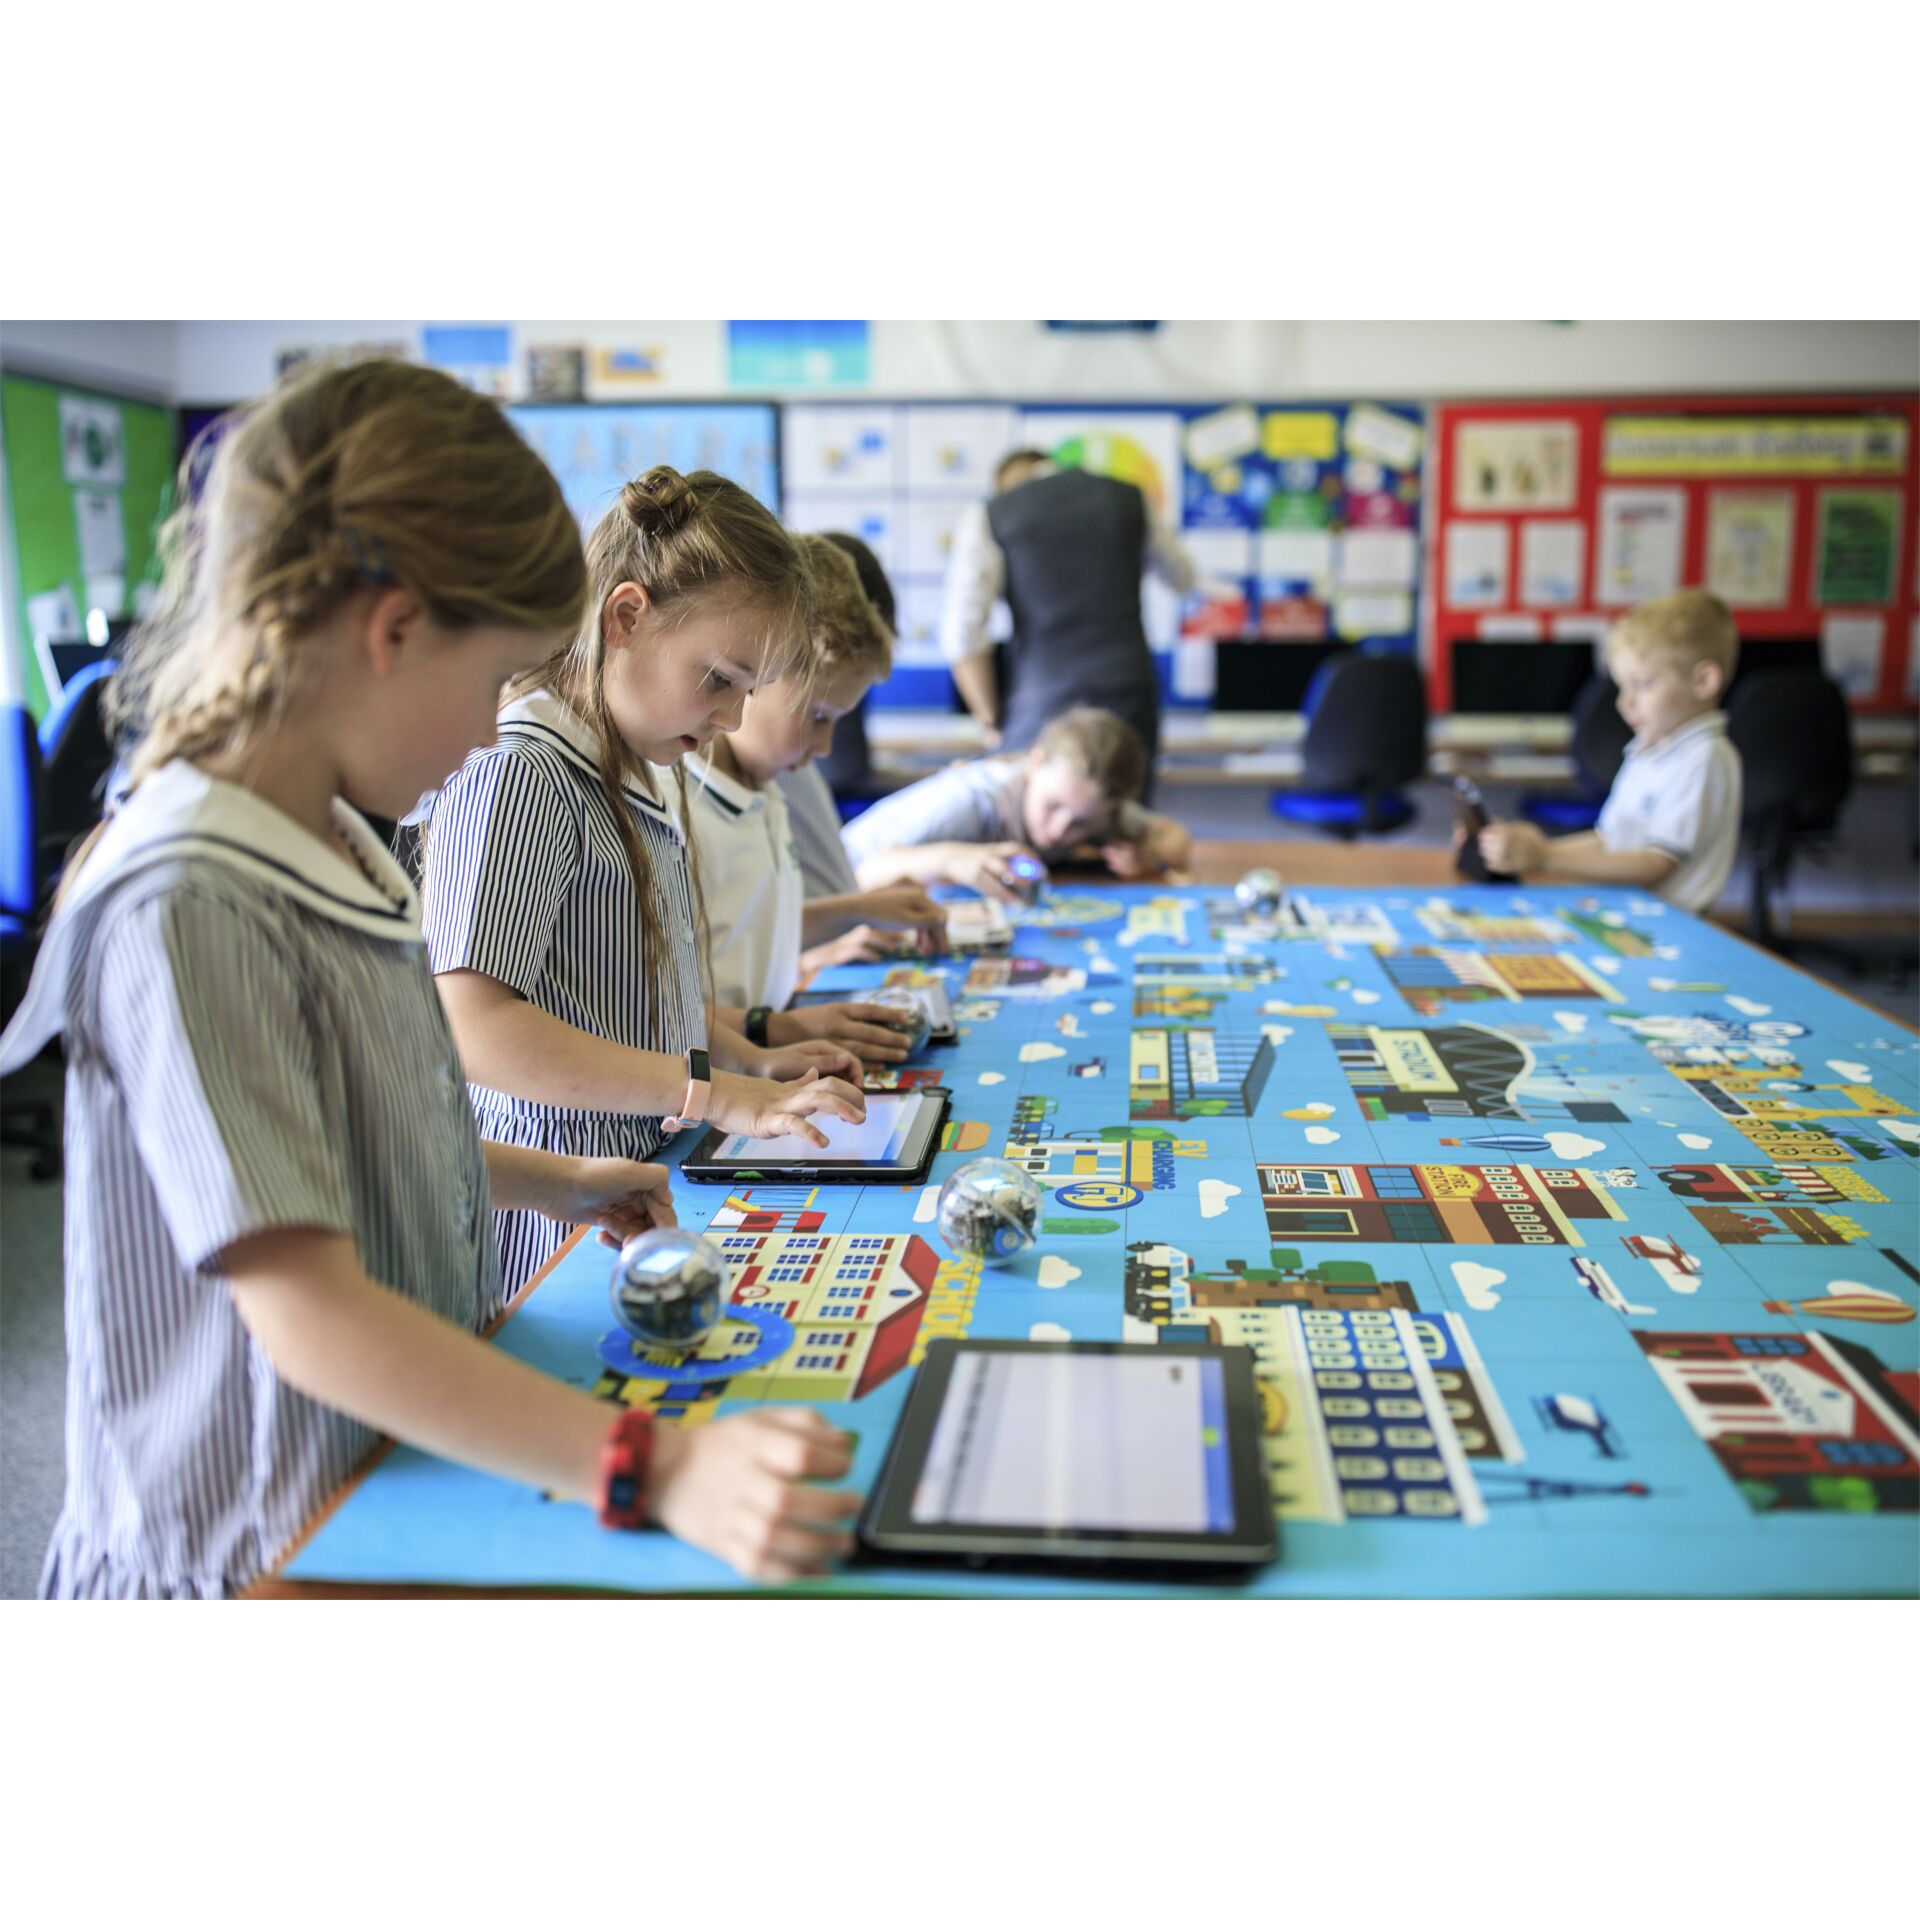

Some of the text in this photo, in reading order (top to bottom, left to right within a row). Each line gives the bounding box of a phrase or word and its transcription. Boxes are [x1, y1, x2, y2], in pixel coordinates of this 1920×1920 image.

[1173, 1140, 1208, 1158] EV
[1152, 1141, 1176, 1190] CHARGING
[1424, 1166, 1457, 1196] STATION
[1447, 1173, 1471, 1189] FIRE
[908, 1257, 984, 1366] SCHOO
